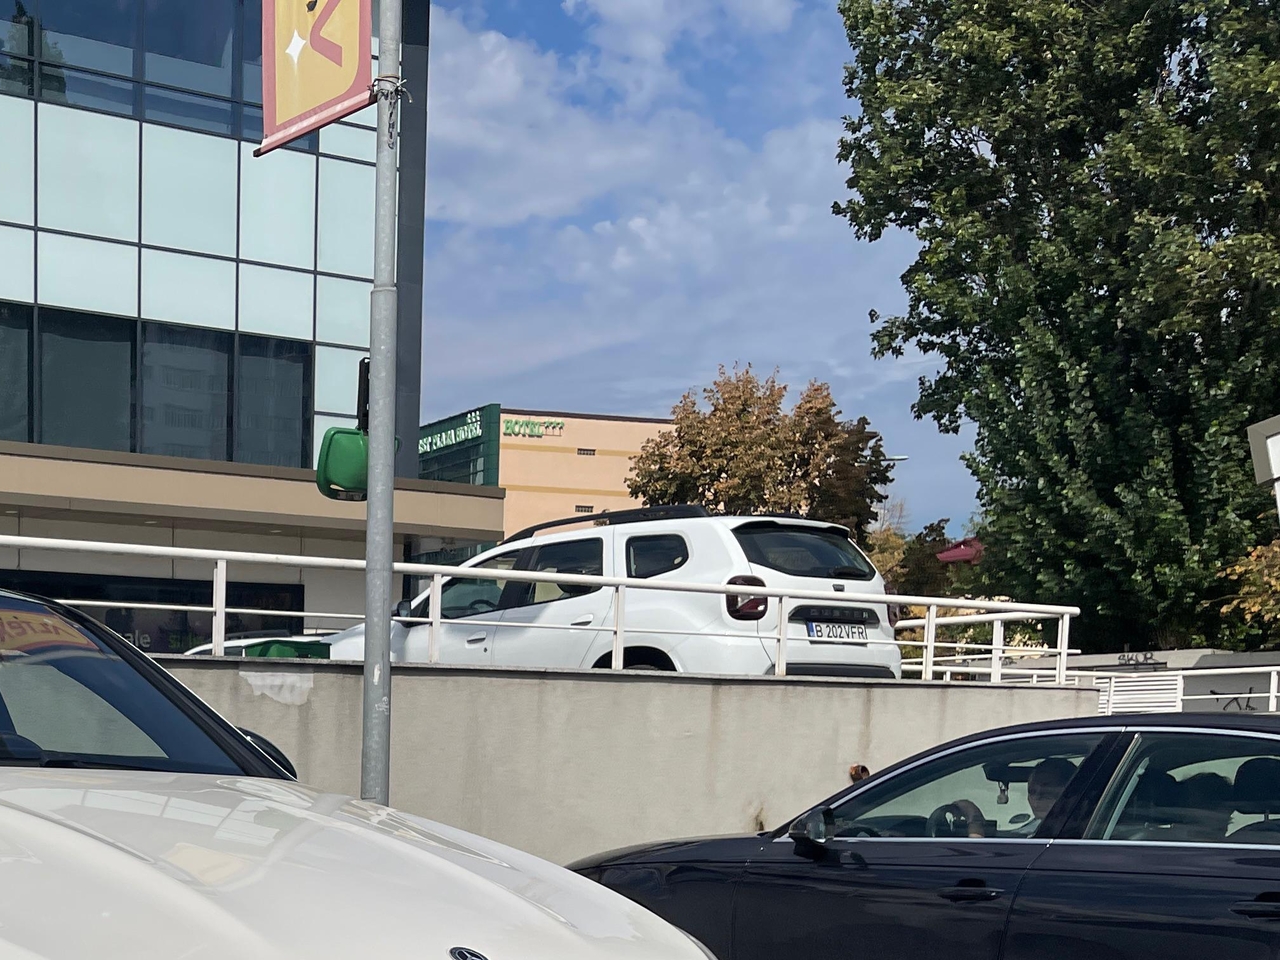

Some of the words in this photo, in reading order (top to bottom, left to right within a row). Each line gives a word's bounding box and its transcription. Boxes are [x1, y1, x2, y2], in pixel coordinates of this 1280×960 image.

[503, 418, 543, 438] HOTEL
[124, 630, 151, 648] ale
[815, 624, 823, 638] B
